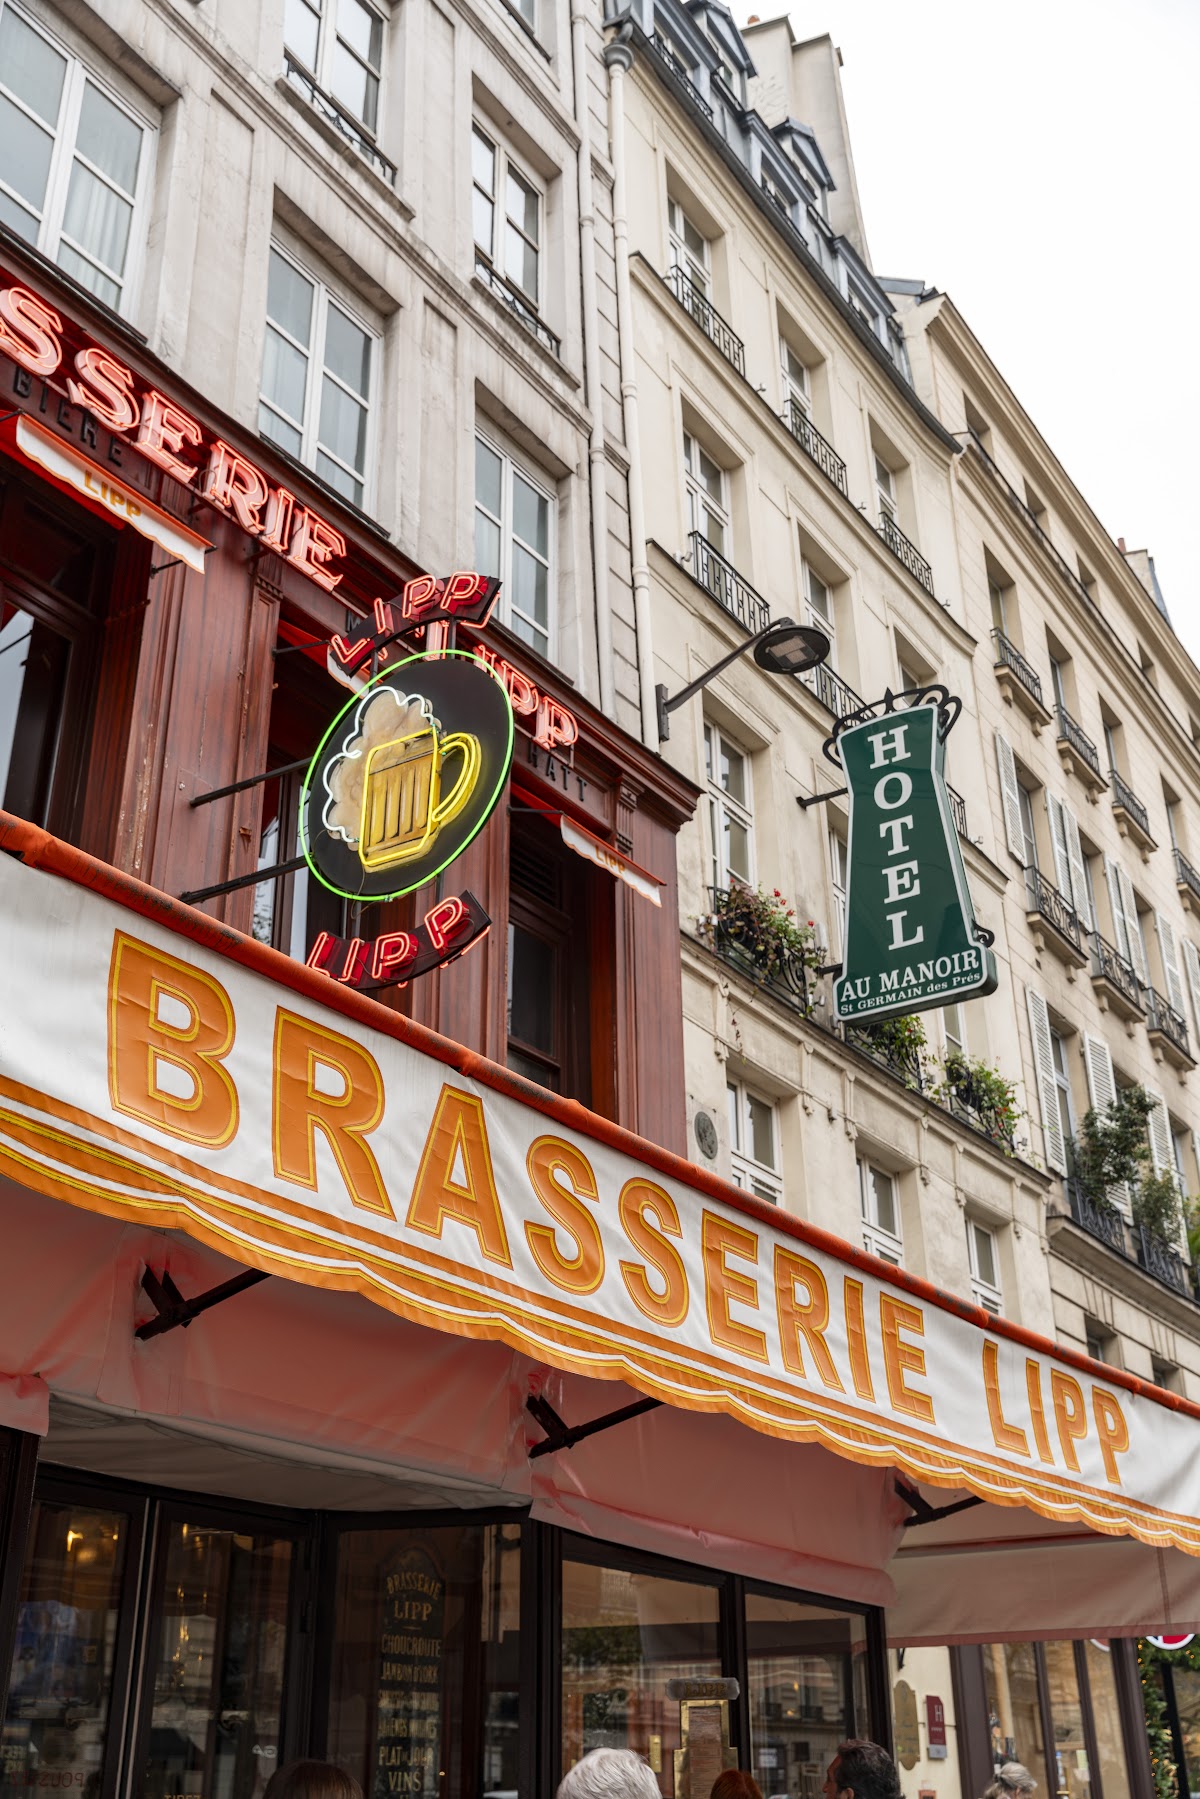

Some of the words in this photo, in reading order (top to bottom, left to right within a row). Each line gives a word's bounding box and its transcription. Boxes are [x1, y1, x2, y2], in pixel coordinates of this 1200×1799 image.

[84, 469, 141, 518] LIPP
[331, 570, 482, 664] LIPP
[867, 724, 925, 952] HOTEL
[595, 844, 626, 874] LIPP
[306, 896, 467, 982] LIPP
[840, 977, 871, 1003] AU
[879, 949, 979, 993] MANOIR
[840, 1004, 854, 1015] St
[857, 986, 922, 1010] GERMAIN
[926, 979, 948, 993] des
[952, 973, 980, 987] Prés
[107, 927, 936, 1425] BRASSERIE
[981, 1339, 1130, 1485] LIPP
[387, 1571, 442, 1600] BRASSERIE
[393, 1600, 433, 1621] LIPP
[381, 1634, 442, 1658] CHOUCROUTE
[685, 1682, 727, 1697] LIPP
[379, 1746, 403, 1766] PLAT
[388, 1771, 422, 1792] VINS
